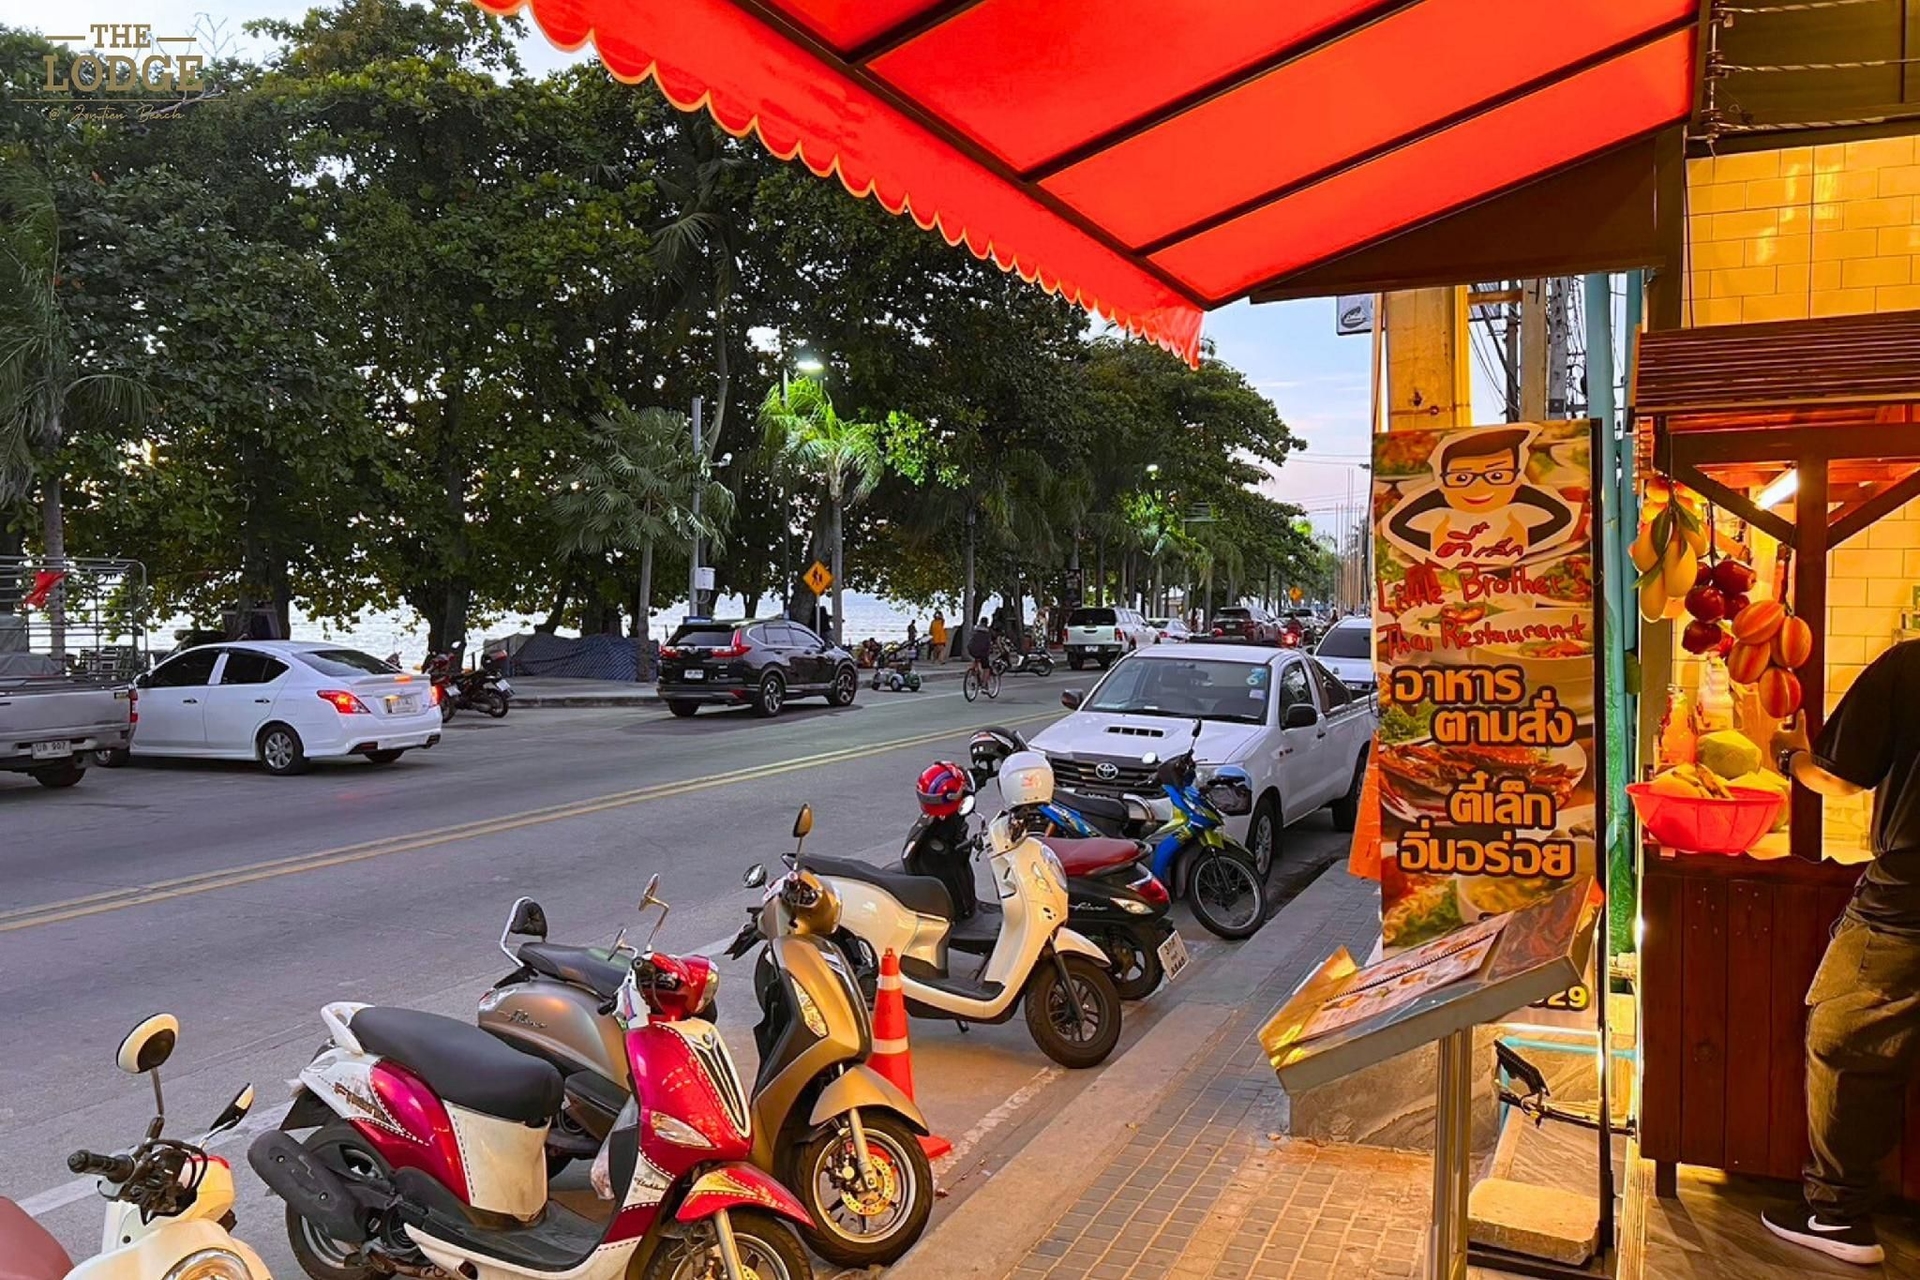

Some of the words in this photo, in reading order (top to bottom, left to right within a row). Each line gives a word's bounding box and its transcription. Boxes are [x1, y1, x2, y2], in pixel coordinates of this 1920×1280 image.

[1376, 622, 1433, 659] Thai
[1440, 613, 1586, 650] Restaurant
[1394, 667, 1523, 703] อาหาร
[1433, 688, 1576, 745] ตามสั่ง
[1399, 817, 1573, 879] อิ่มอร่อย
[1533, 985, 1588, 1009] 29
